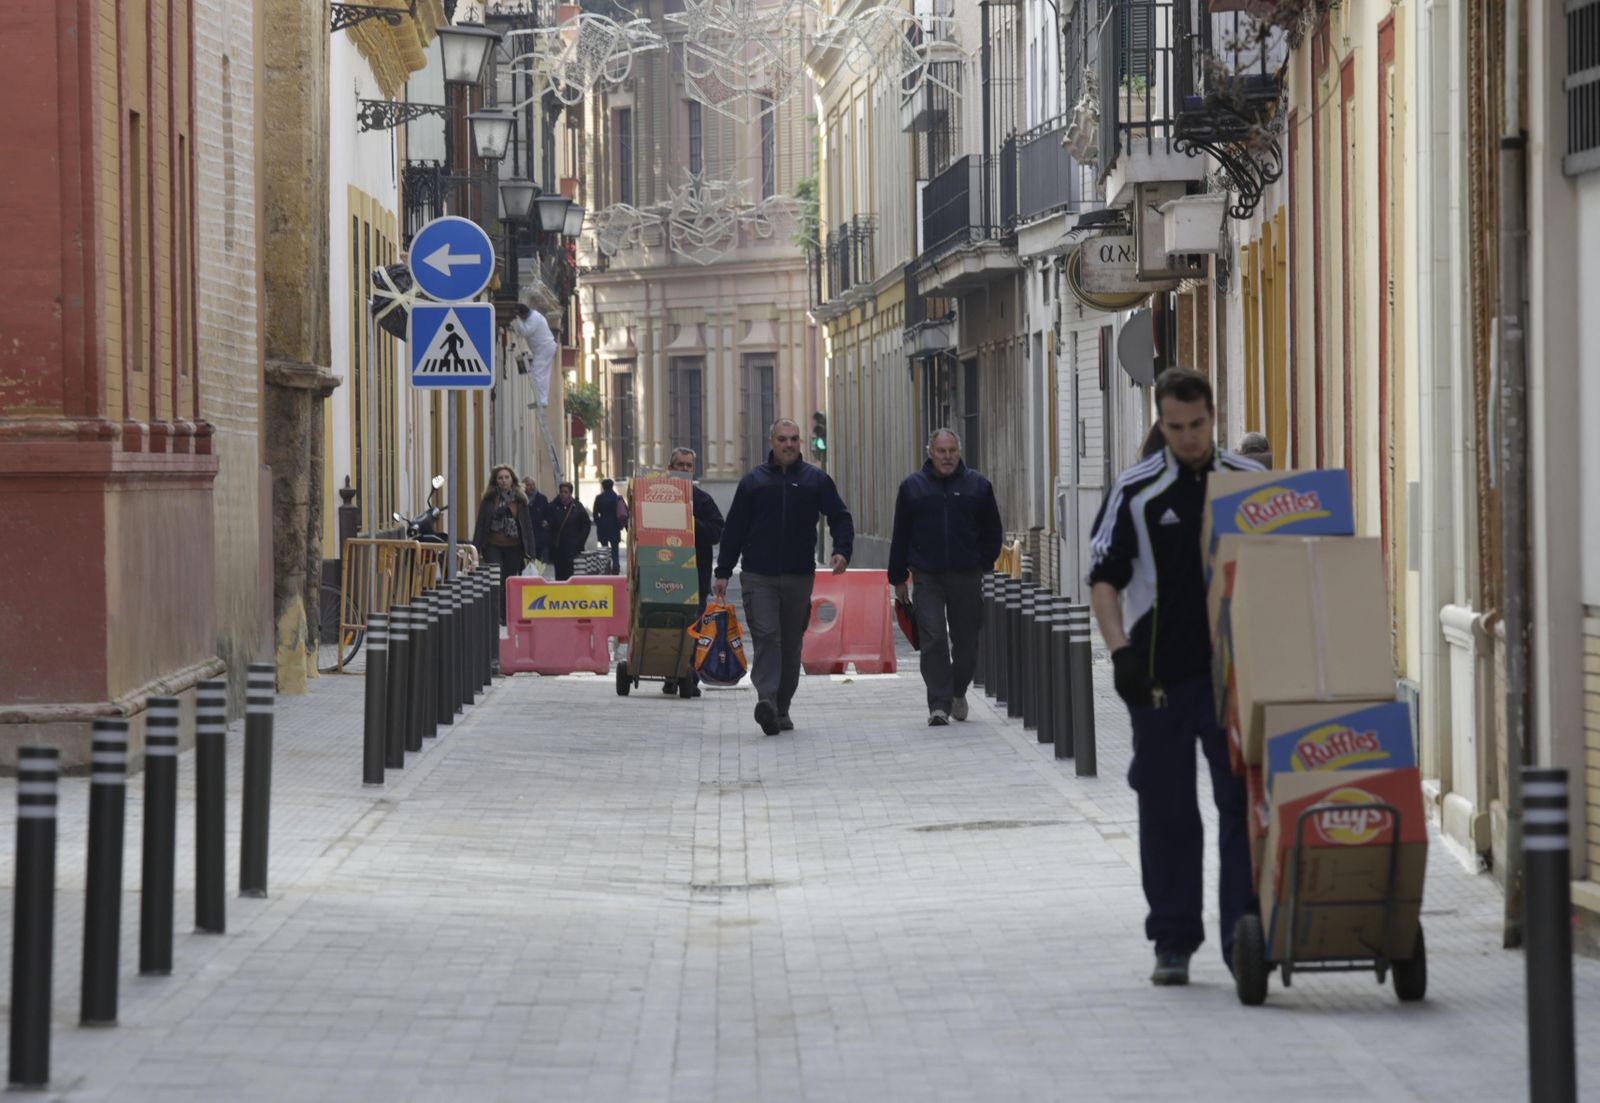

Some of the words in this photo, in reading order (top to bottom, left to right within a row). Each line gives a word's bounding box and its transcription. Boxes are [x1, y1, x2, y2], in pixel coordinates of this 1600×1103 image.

[1239, 489, 1321, 528] Ruffles
[548, 600, 609, 610] MAYGAR
[1297, 729, 1380, 768] Ruffles
